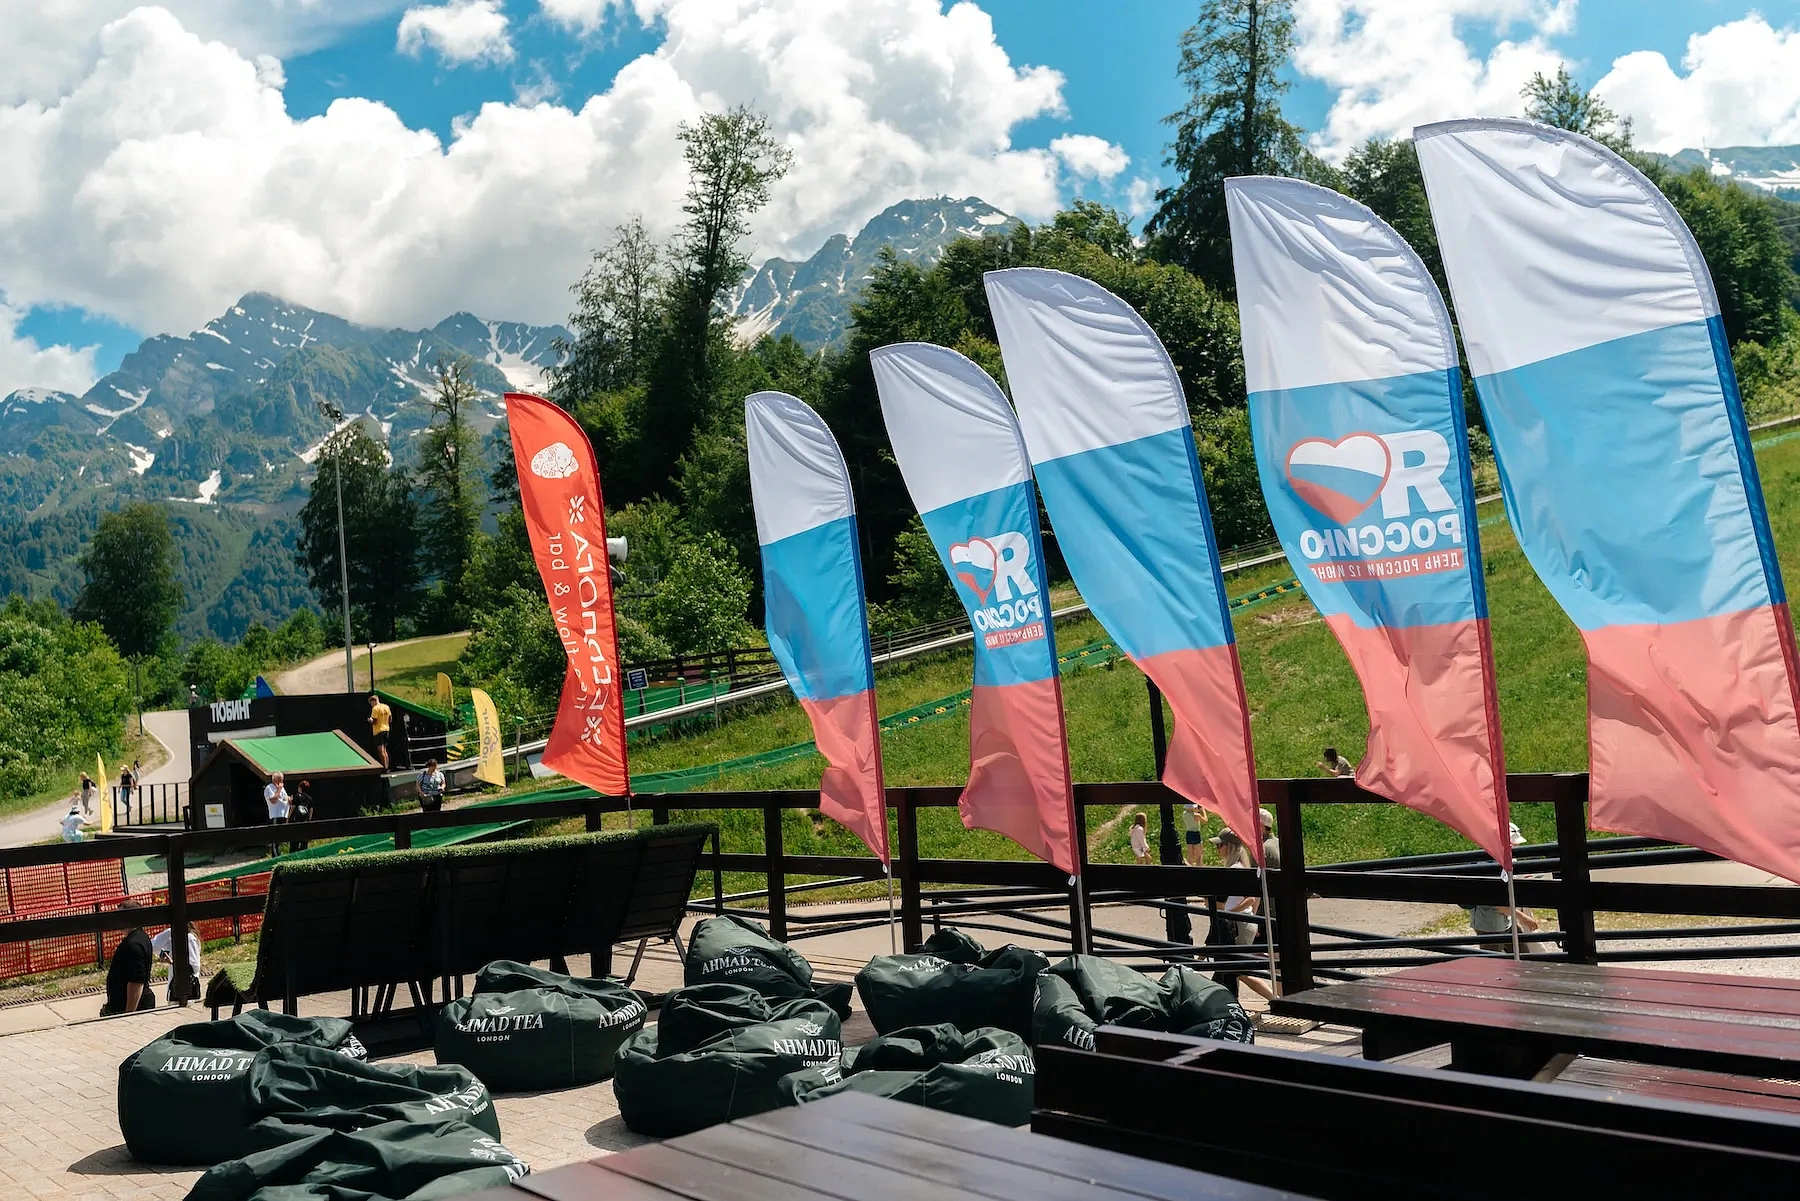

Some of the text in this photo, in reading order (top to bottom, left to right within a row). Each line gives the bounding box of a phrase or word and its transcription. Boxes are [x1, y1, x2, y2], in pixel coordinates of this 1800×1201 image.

[210, 698, 251, 723] ТЮБИНГ
[702, 955, 750, 975] AHMAD
[725, 967, 753, 976] LONDON
[513, 1013, 544, 1030] TEA
[477, 1034, 510, 1042] LONDON
[773, 1039, 826, 1056] AHMAD
[160, 1056, 234, 1072] AHMAD
[192, 1073, 231, 1081] LONDON
[996, 1071, 1023, 1085] LONDON
